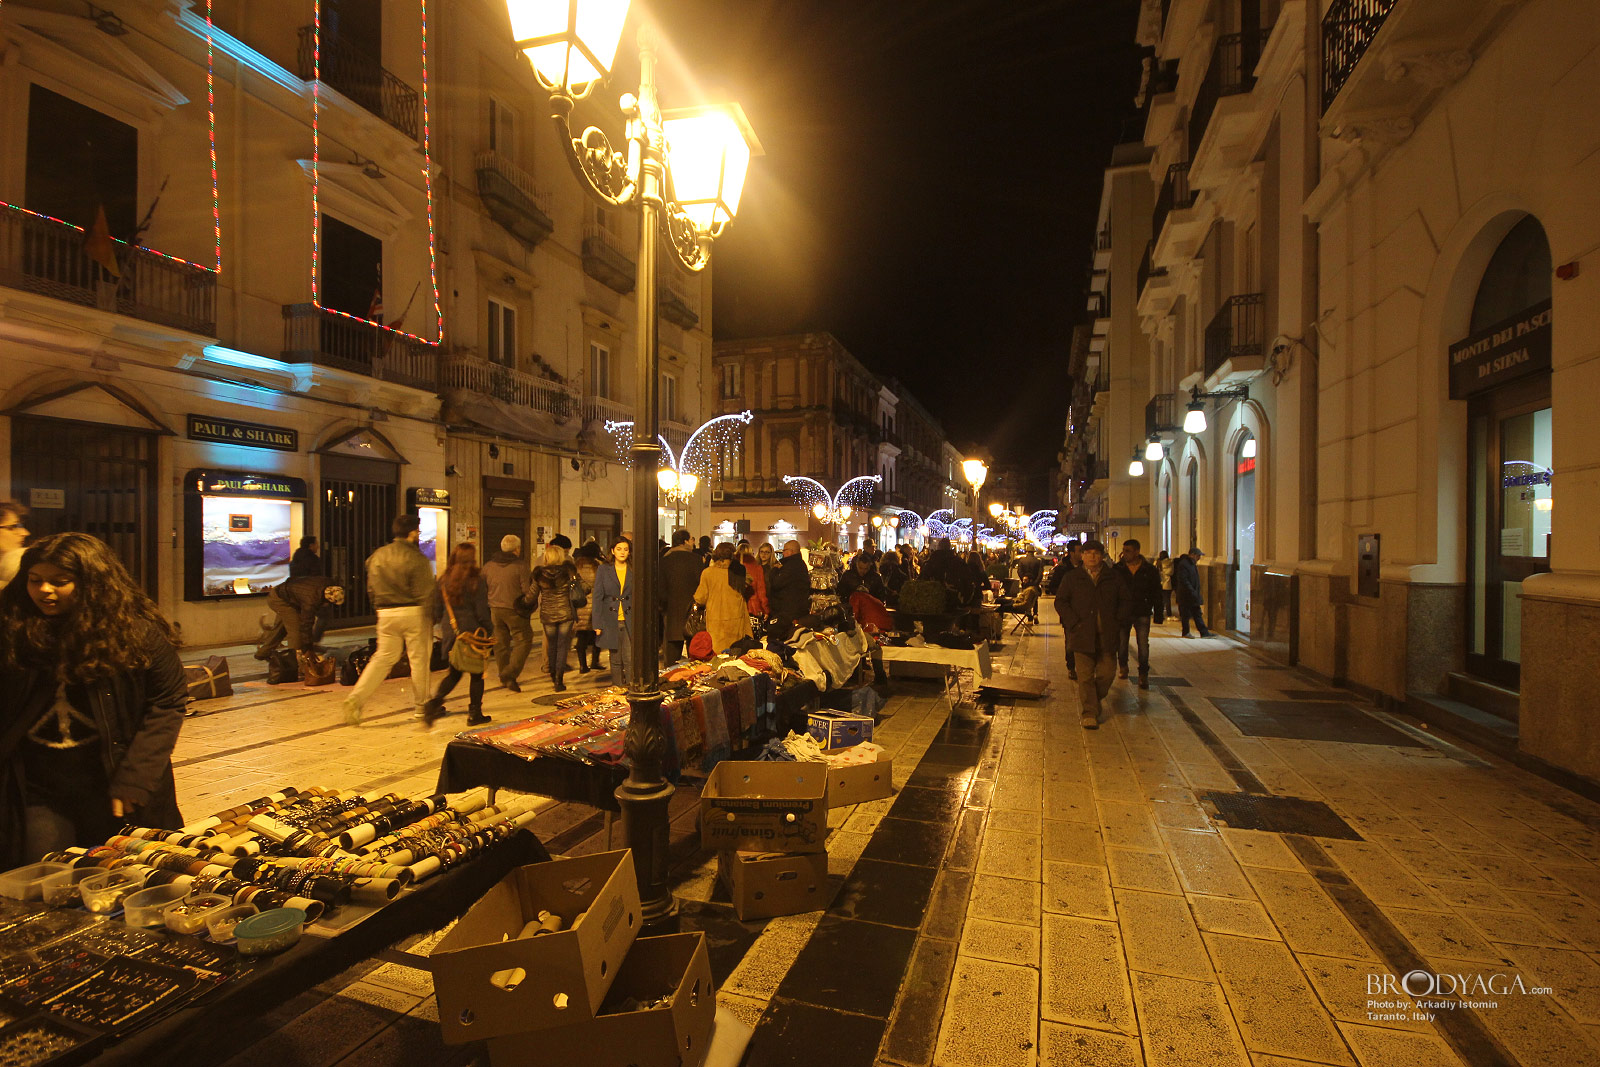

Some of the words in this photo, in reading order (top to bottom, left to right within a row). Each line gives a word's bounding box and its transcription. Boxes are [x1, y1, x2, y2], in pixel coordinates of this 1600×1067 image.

[1453, 337, 1490, 366] MONTE
[1493, 327, 1513, 348] DEI
[1478, 362, 1491, 378] DI
[1493, 347, 1530, 373] SIENA
[194, 422, 230, 437] PAUL
[232, 428, 243, 439] &
[246, 429, 292, 445] SHARK
[217, 479, 243, 490] PAUL
[257, 482, 291, 493] SHARK
[716, 800, 761, 810] Bananas
[763, 801, 810, 810] Premium
